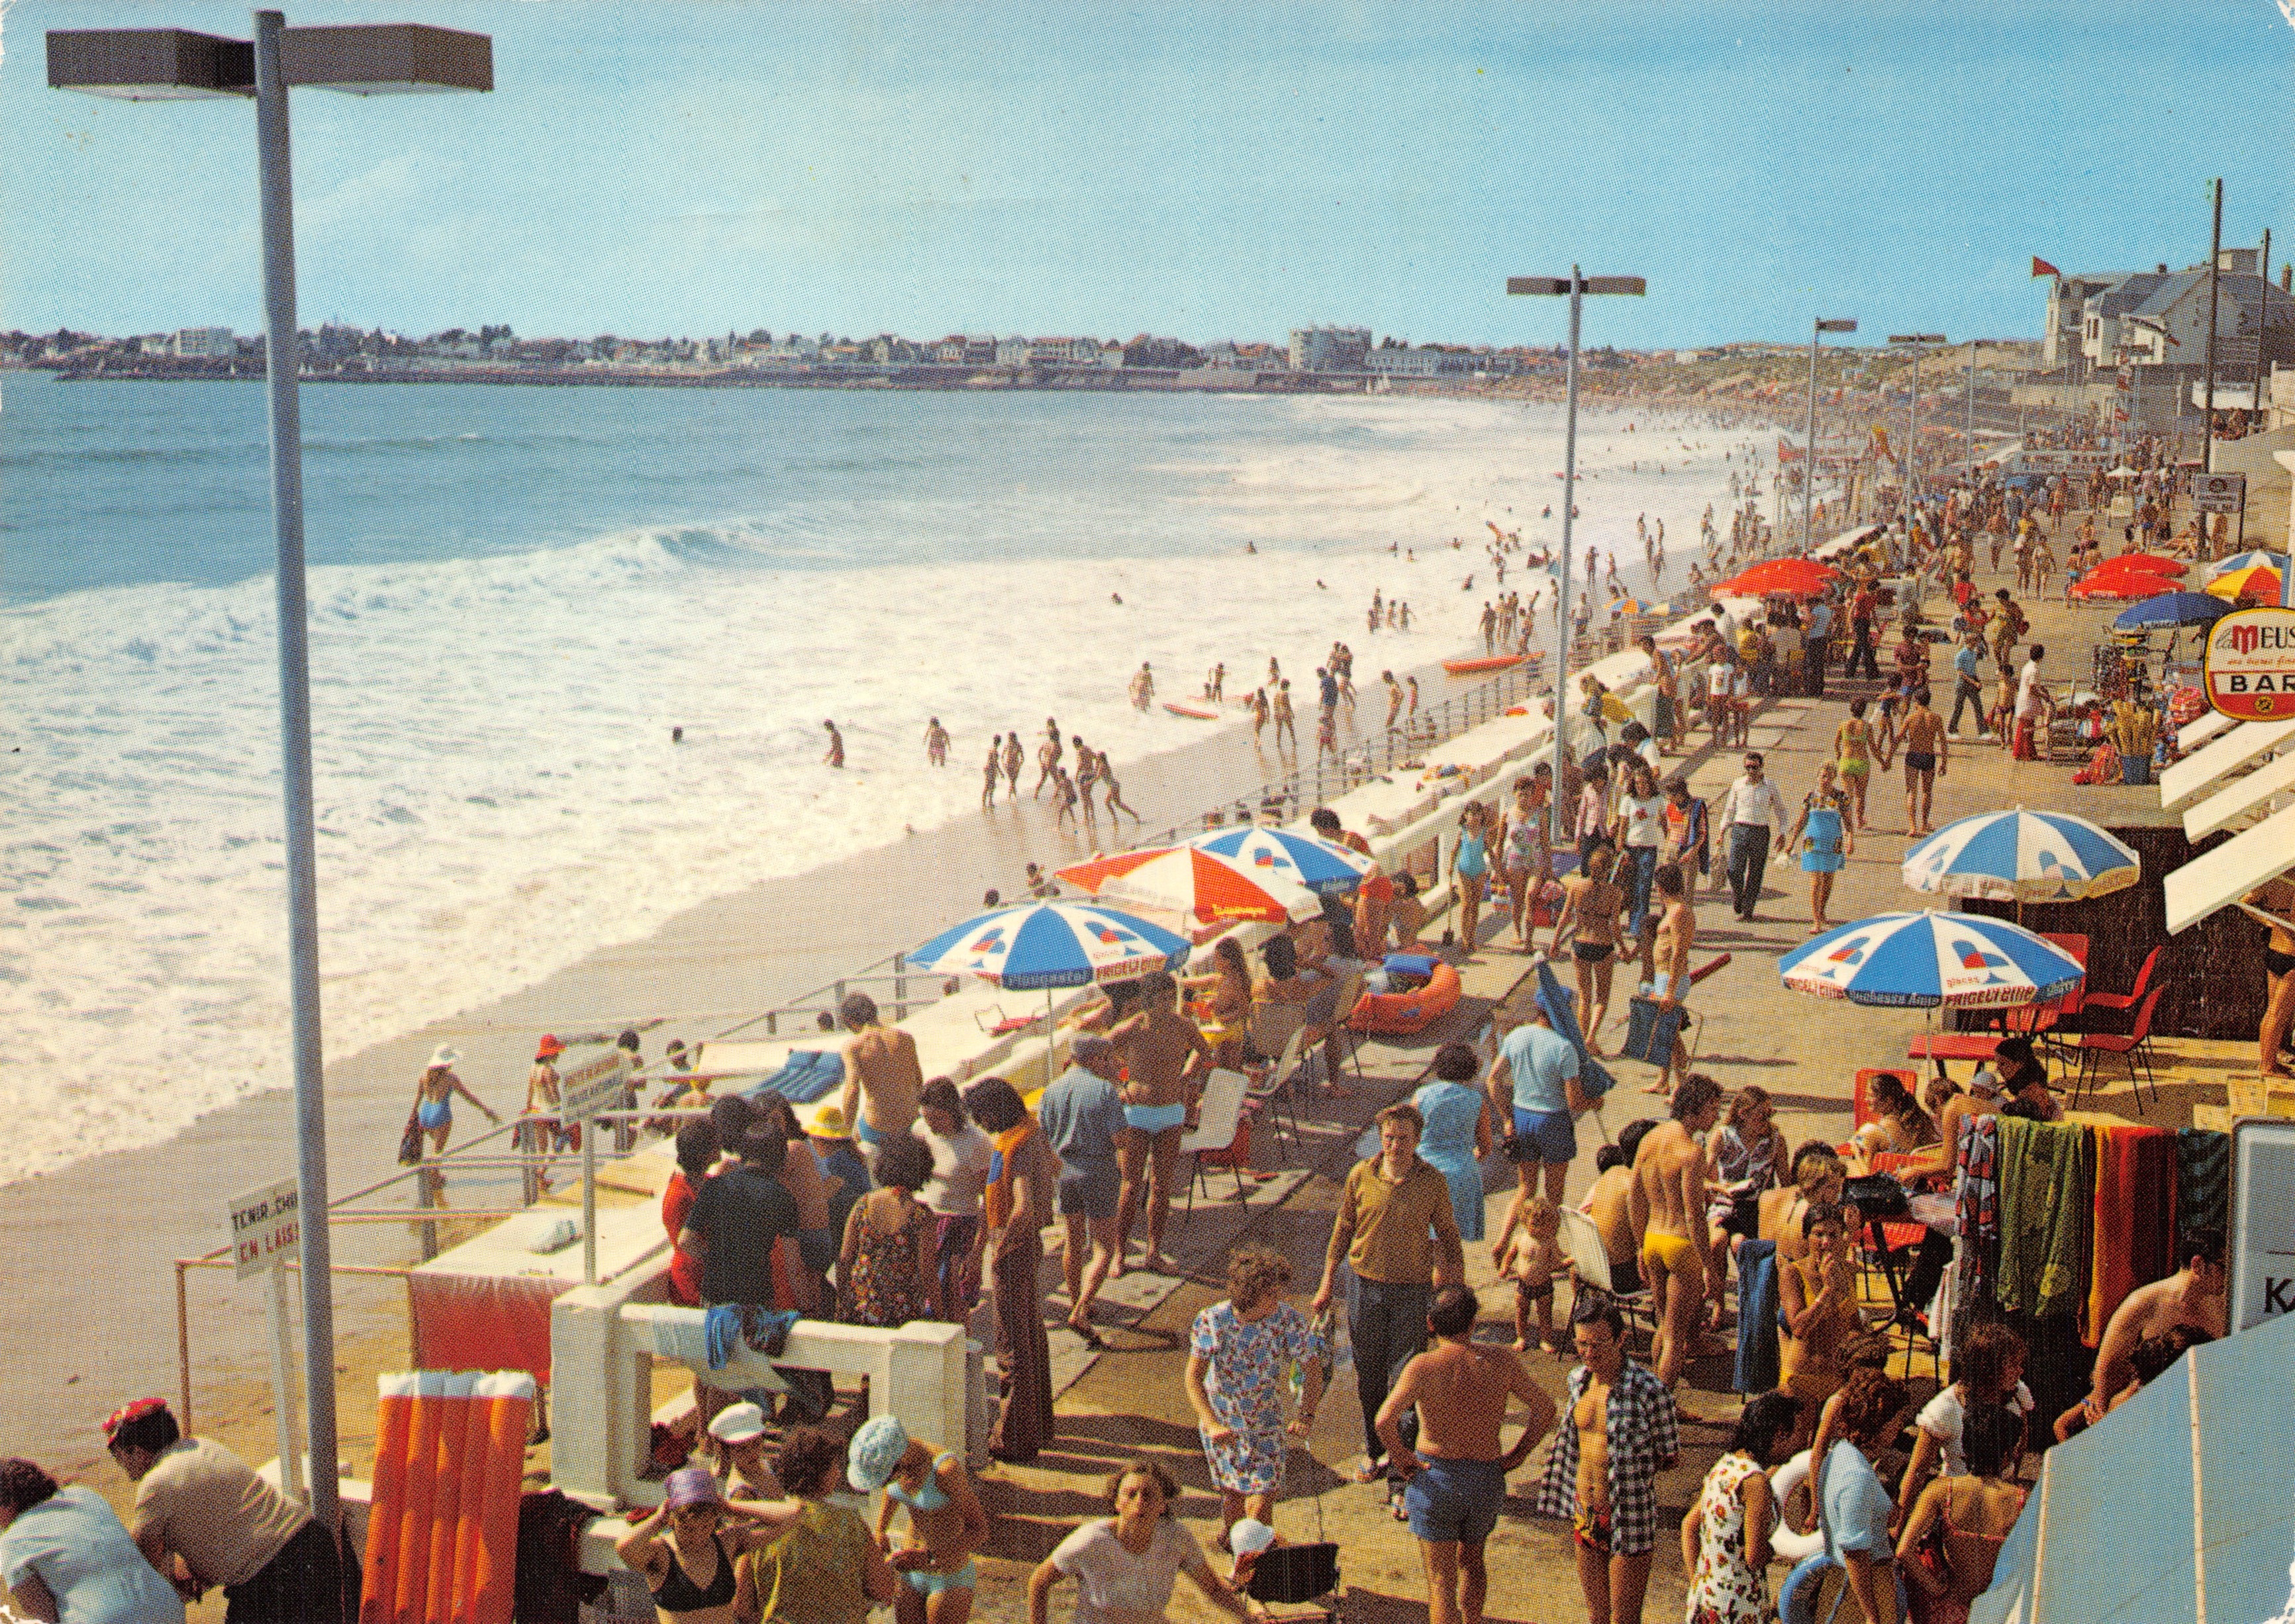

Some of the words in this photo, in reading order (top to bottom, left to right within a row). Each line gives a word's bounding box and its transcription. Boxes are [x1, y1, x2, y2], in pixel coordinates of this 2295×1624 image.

[2230, 675, 2295, 693] BAR
[240, 1238, 259, 1263] EN
[2264, 1276, 2295, 1314] K
